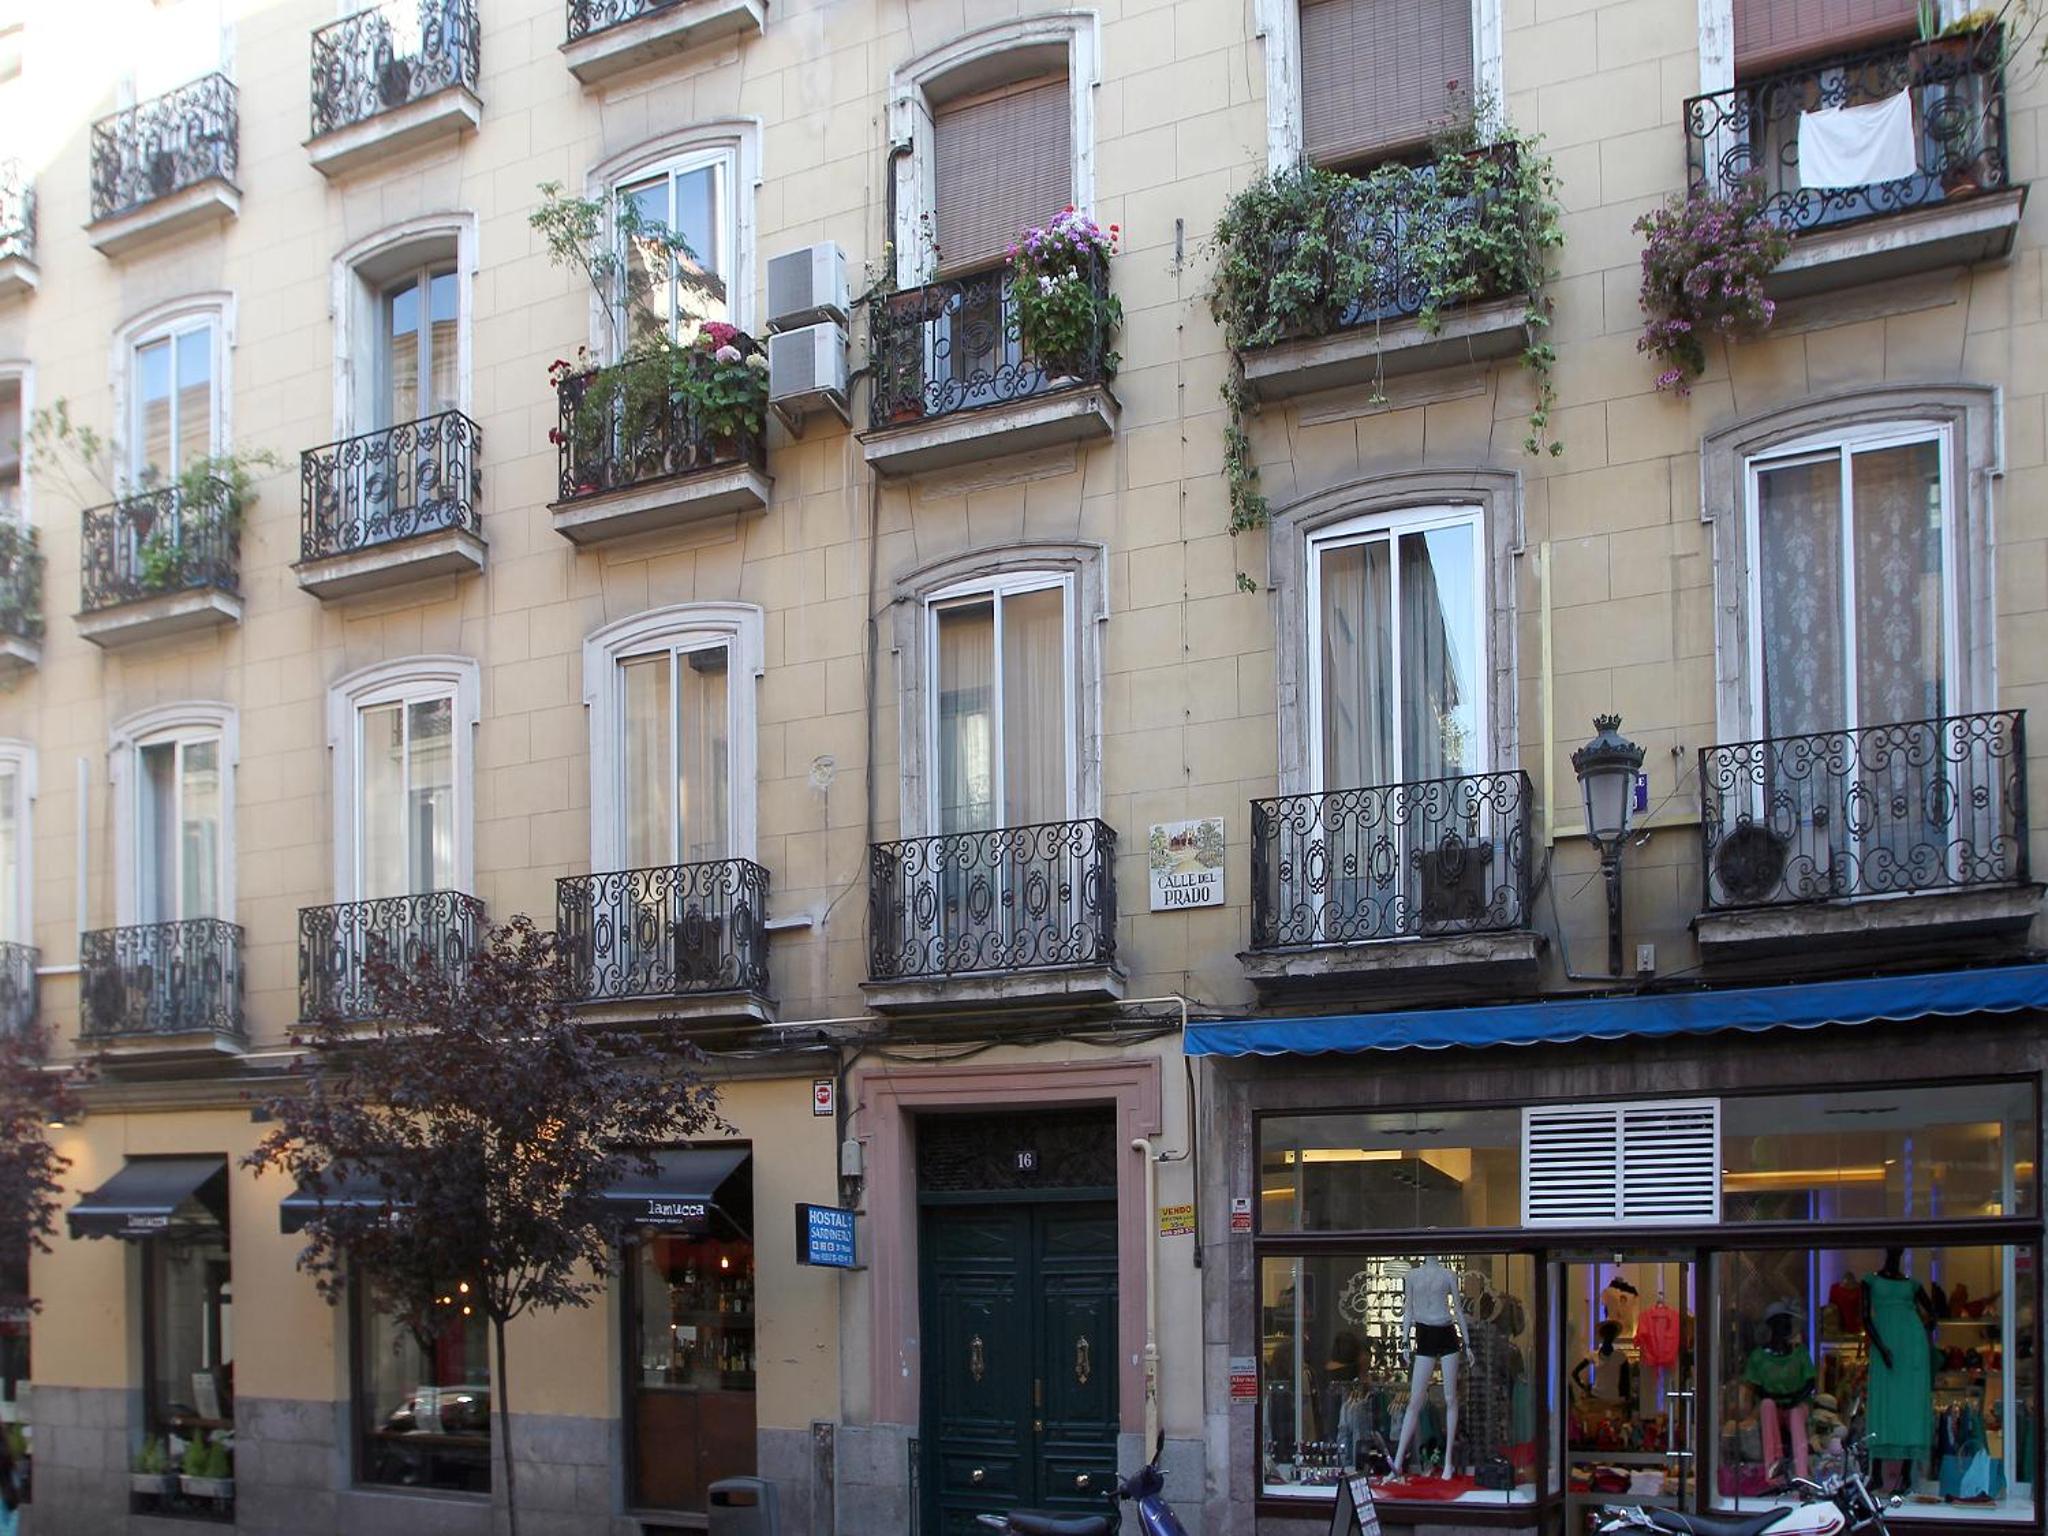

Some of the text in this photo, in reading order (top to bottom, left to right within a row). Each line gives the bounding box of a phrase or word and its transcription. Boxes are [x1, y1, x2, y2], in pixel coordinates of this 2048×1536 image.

[1158, 873, 1217, 889] CALLE DEL
[1164, 886, 1210, 905] PRADO
[1018, 1152, 1032, 1169] 16
[648, 1200, 704, 1216] lamucca
[1162, 1205, 1192, 1216] VENDO
[809, 1210, 848, 1227] HOSTAL
